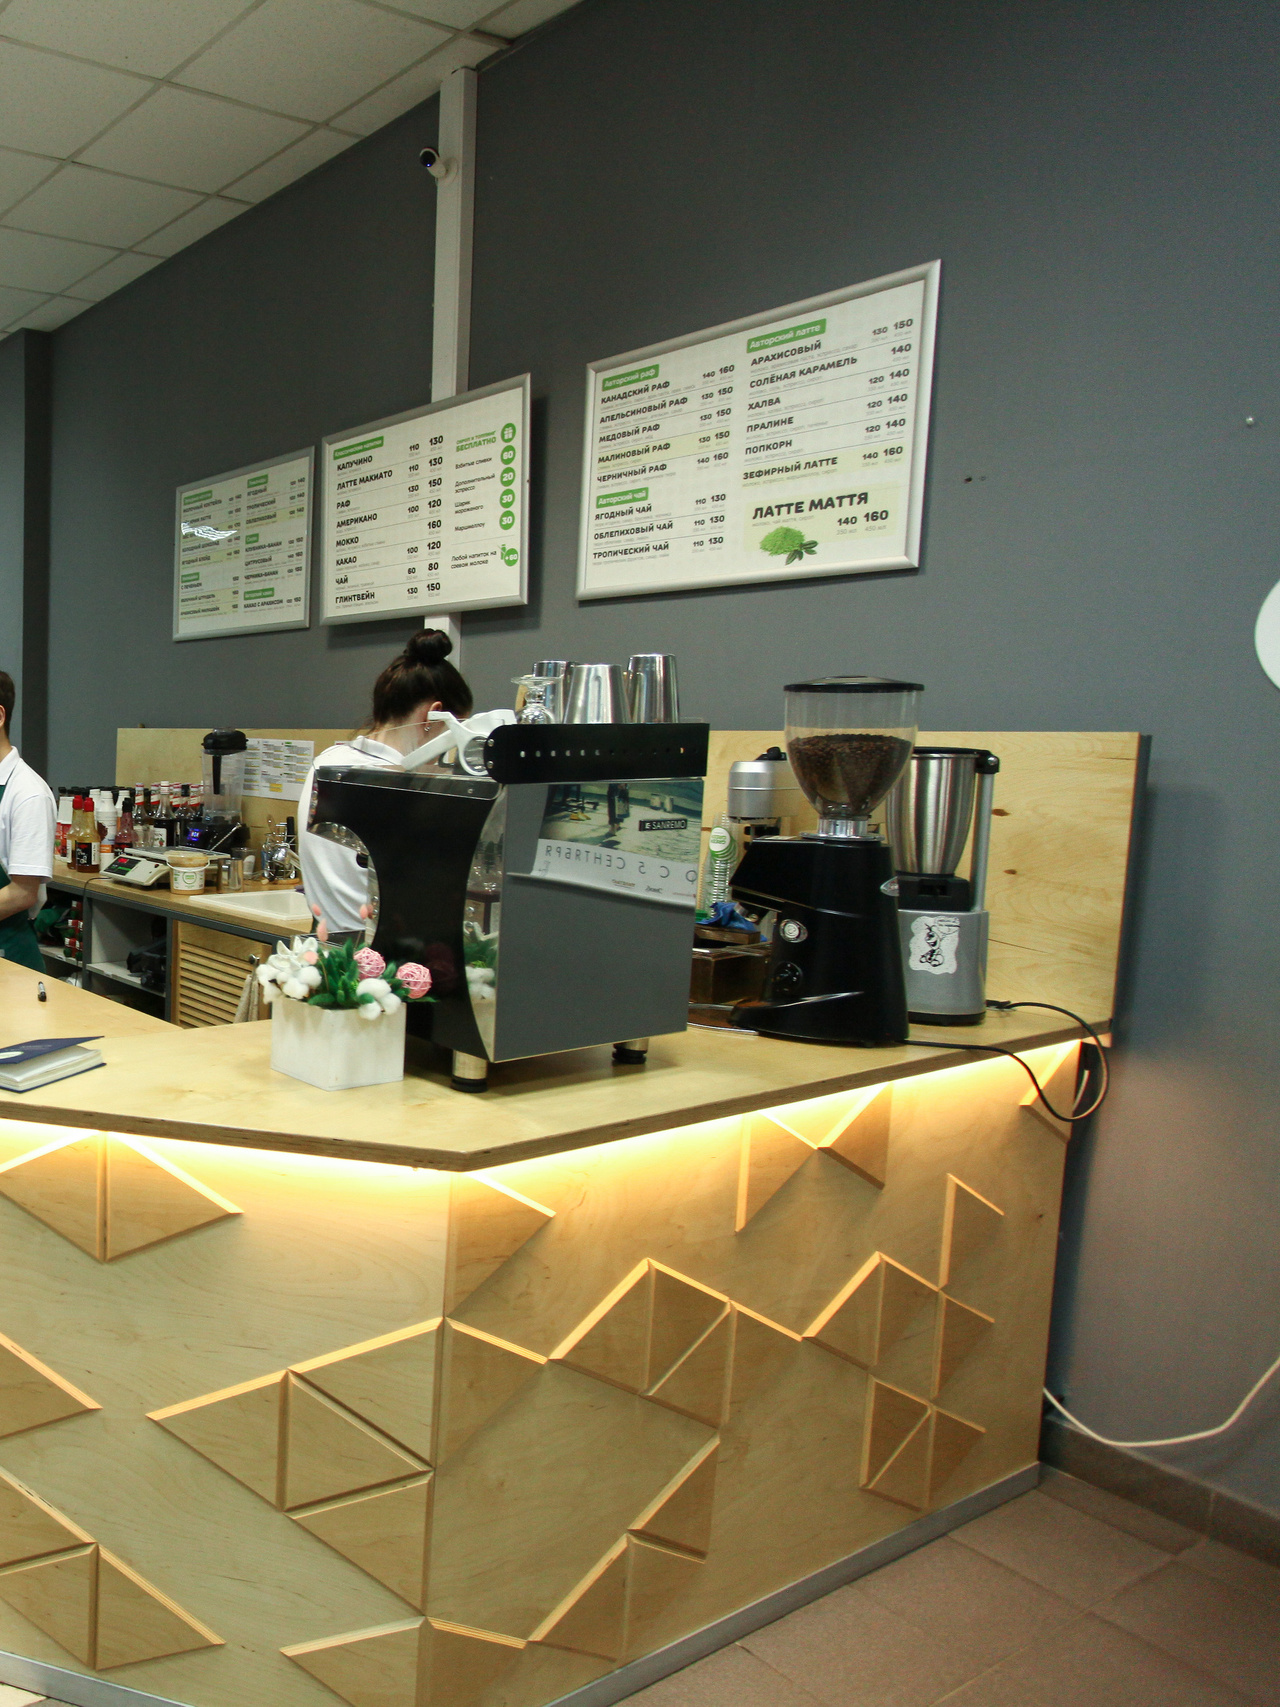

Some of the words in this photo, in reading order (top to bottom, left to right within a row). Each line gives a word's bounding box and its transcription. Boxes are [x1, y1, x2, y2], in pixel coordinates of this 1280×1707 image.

[749, 330, 796, 348] Авторский
[796, 324, 820, 338] латте
[751, 340, 822, 366] АРАХИСОВЫЙ
[872, 326, 888, 336] 130
[893, 318, 913, 330] 150
[604, 373, 639, 388] Авторский
[640, 369, 656, 382] раф
[750, 370, 796, 389] СОЛЁНАЯ
[798, 356, 858, 377] КАРАМЕЛЬ
[891, 343, 912, 354] 140
[601, 384, 650, 404] КАНАДСКИЙ
[651, 381, 670, 393] РАФ
[703, 370, 715, 379] 140
[719, 365, 735, 375] 160
[748, 396, 781, 411] ХАЛВА
[868, 375, 885, 385] 120
[889, 368, 910, 380] 140
[600, 402, 667, 424] АПЕЛЬСИНОВЫЙ
[669, 397, 688, 408] РАФ
[701, 392, 714, 401] 130
[717, 386, 733, 396] 150
[746, 416, 794, 433] ПРАЛИНЕ
[866, 400, 883, 409] 120
[887, 393, 908, 405] 140
[599, 426, 640, 443] МЕДОВЫЙ
[642, 423, 660, 434] РАФ
[700, 413, 712, 421] 130
[716, 408, 732, 418] 150
[745, 439, 792, 455] ПОПКОРН
[865, 424, 881, 434] 120
[886, 418, 906, 429] 140
[337, 455, 373, 471] КАПУЧИНО
[409, 444, 420, 452] 110
[429, 435, 444, 446] 130
[456, 436, 496, 452] БЕСПЛАТНО
[503, 450, 514, 459] 60
[598, 445, 650, 464] МАЛИНОВЫЙ
[652, 442, 670, 453] РАФ
[698, 436, 711, 444] 130
[715, 431, 730, 440] 150
[337, 478, 358, 490] ЛАТТЕ
[359, 470, 393, 485] МАКИАТО
[409, 464, 419, 472] 110
[429, 456, 443, 466] 130
[597, 466, 648, 483] ЧЕРНИЧНЫЙ
[649, 463, 667, 474] РАФ
[697, 456, 709, 465] 140
[713, 452, 729, 461] 160
[742, 461, 802, 480] ЗЕФИРНЫЙ
[804, 457, 838, 470] ЛАТТЕ
[862, 451, 878, 460] 140
[883, 446, 903, 457] 160
[503, 473, 514, 481] 20
[336, 500, 351, 509] РАФ
[408, 485, 419, 493] 130
[428, 478, 442, 488] 150
[502, 495, 513, 503] 30
[598, 493, 633, 505] Авторский
[634, 490, 646, 499] чай
[752, 501, 804, 520] ЛАТТЕ
[808, 492, 869, 512] МАТТЯ
[336, 513, 378, 528] АМЕРИКАНО
[408, 505, 419, 513] 100
[428, 498, 442, 509] 120
[502, 516, 513, 524] 30
[595, 507, 634, 521] ЯГОДНЫЙ
[635, 503, 652, 514] ЧАЙ
[695, 497, 706, 505] 110
[711, 494, 726, 502] 130
[837, 516, 858, 526] 140
[864, 510, 889, 522] 160
[336, 536, 359, 547] МОККО
[427, 520, 442, 530] 160
[594, 524, 654, 540] ОБЛЕПИХОВЫЙ
[656, 521, 673, 531] ЧАЙ
[709, 515, 725, 524] 130
[336, 556, 357, 566] КАКАО
[407, 546, 418, 554] 100
[427, 541, 441, 550] 120
[451, 554, 468, 562] Любой
[470, 552, 489, 561] напиток
[505, 553, 518, 561] +60
[593, 544, 650, 559] ТРОПИЧЕСКИЙ
[652, 541, 669, 551] ЧАЙ
[693, 540, 704, 548] 110
[708, 536, 723, 545] 130
[336, 575, 349, 585] ЧАЙ
[428, 562, 439, 571] 80
[335, 591, 375, 604] ГЛИНТВЕЙН
[427, 582, 441, 591] 150
[652, 819, 686, 830] SANREMO
